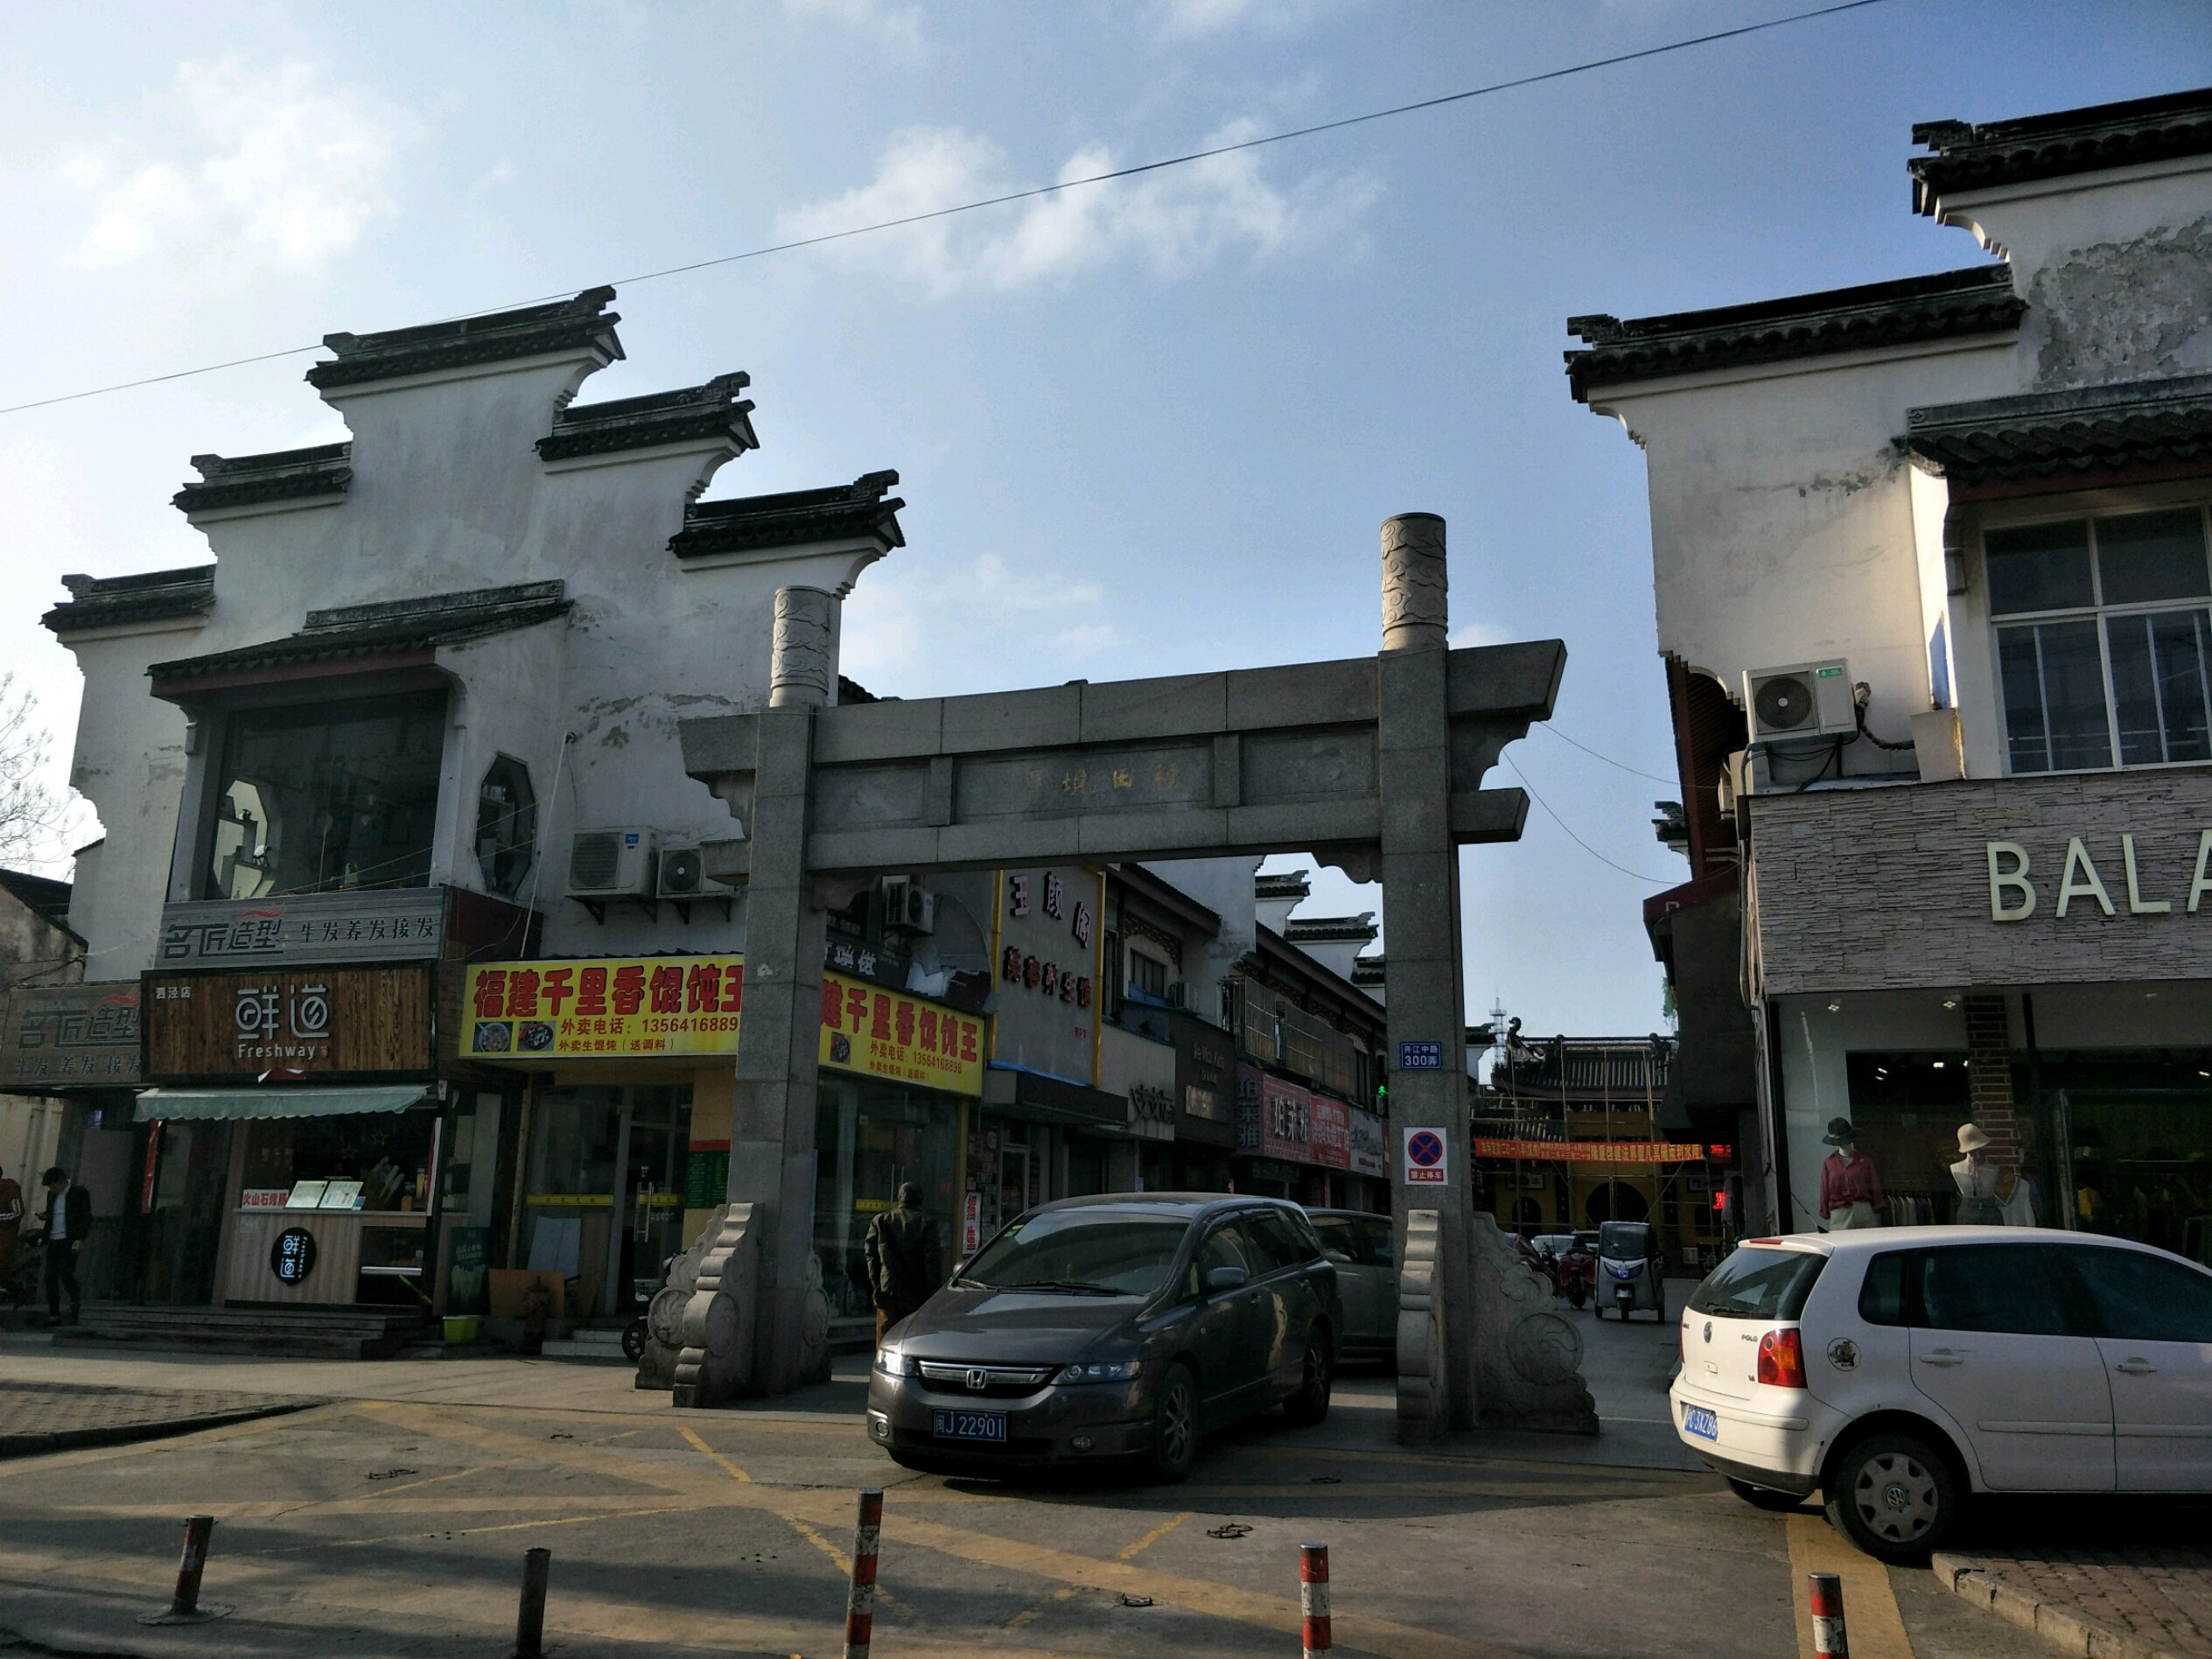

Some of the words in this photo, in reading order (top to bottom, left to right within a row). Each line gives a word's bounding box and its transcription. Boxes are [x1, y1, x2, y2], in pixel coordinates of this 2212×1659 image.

[163, 920, 284, 960] 名匠造型
[156, 987, 192, 999] 泗泾店
[473, 964, 743, 1018] 福建千里香馄饨王
[642, 1017, 738, 1033] 1356416889
[822, 978, 977, 1062] 建千里香馄饨王
[238, 1044, 316, 1060] Freshway
[1404, 1046, 1438, 1054] 开江中路
[1404, 1055, 1438, 1067] 300弄
[1410, 1171, 1443, 1180] 禁止停车
